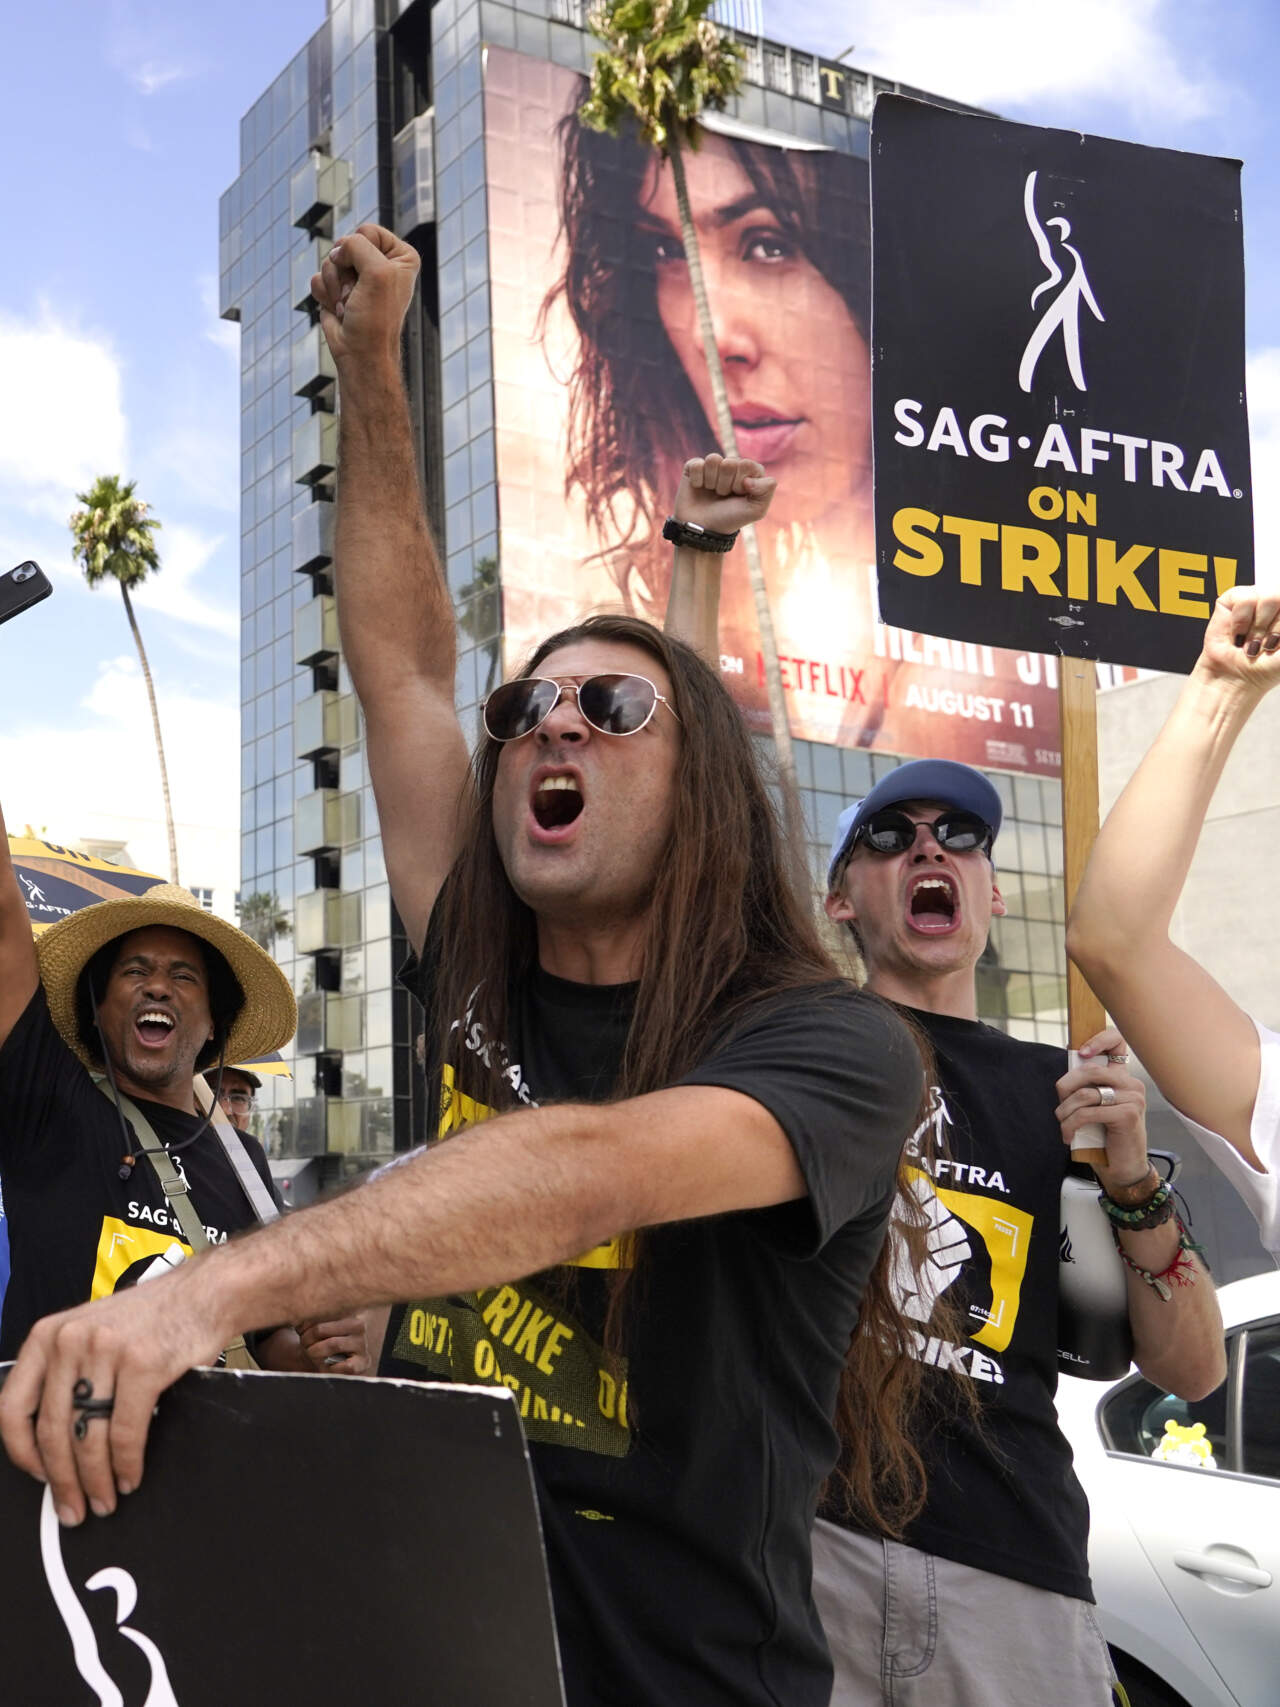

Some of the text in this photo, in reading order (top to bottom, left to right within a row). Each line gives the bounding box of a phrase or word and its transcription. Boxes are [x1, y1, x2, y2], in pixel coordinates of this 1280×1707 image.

[1027, 485, 1098, 528] ON
[891, 506, 1239, 620] STRIKE!
[757, 651, 866, 706] ETFLIX
[904, 683, 1035, 729] AUGUST 11
